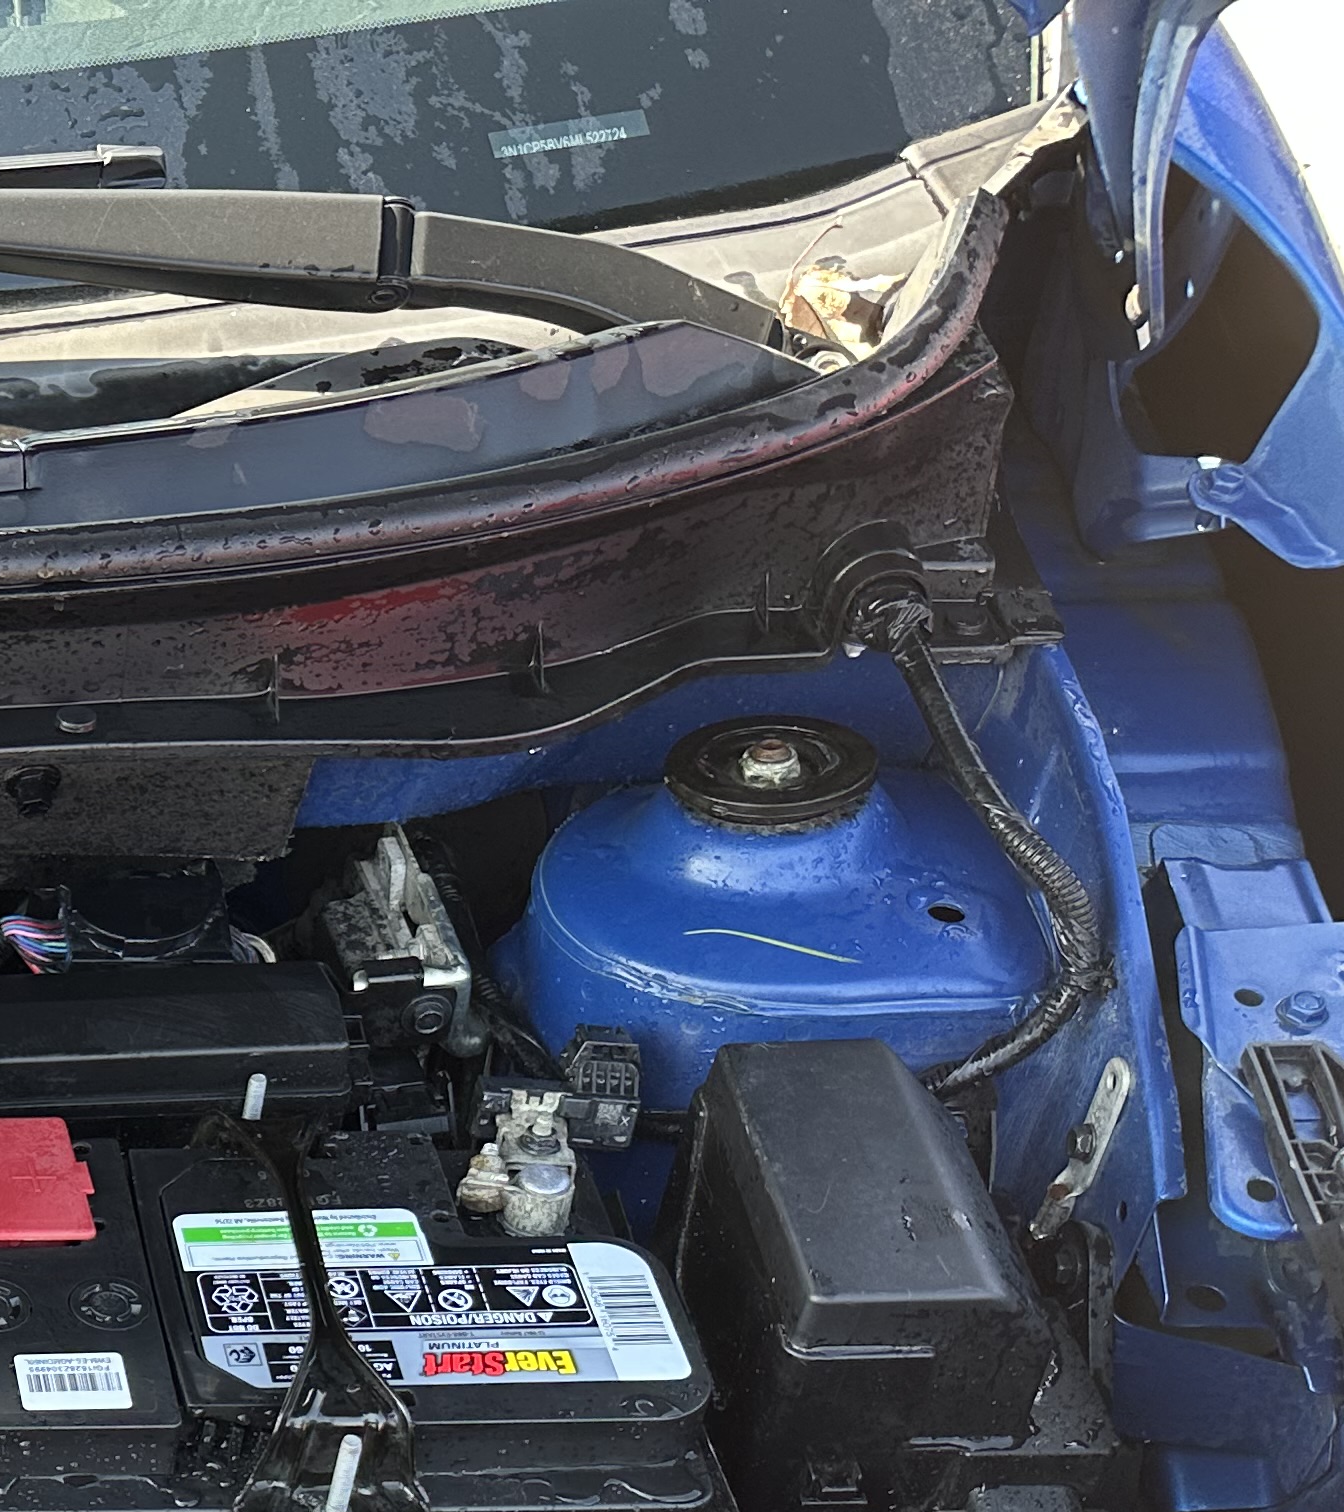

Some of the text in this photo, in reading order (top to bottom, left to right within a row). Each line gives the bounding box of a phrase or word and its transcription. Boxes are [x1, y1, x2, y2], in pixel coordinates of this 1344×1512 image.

[409, 1312, 536, 1326] DANGER/POISON
[428, 1341, 499, 1350] PLATINUM
[423, 1350, 577, 1377] EverStart
